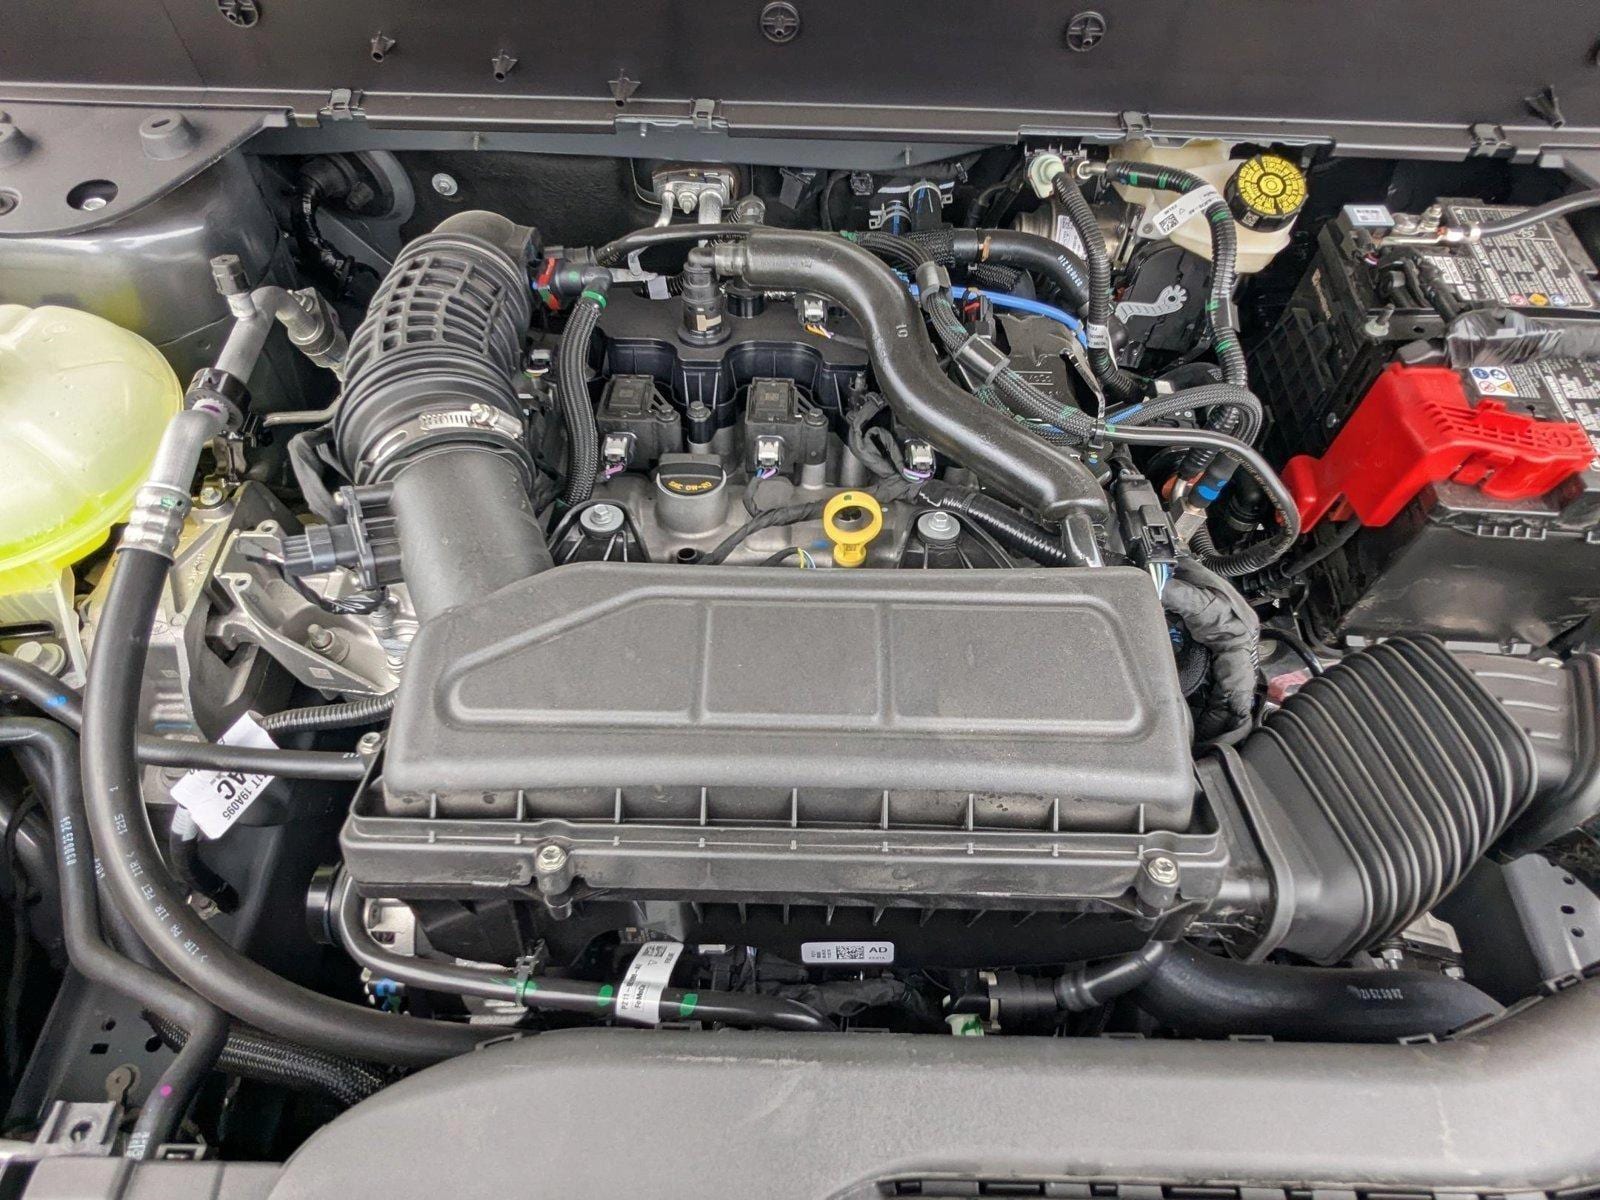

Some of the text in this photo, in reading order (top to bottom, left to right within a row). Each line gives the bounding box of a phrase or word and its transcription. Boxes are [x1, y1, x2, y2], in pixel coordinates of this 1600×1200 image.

[217, 770, 247, 801] AC
[222, 787, 253, 821] 19A095
[868, 946, 889, 954] AD
